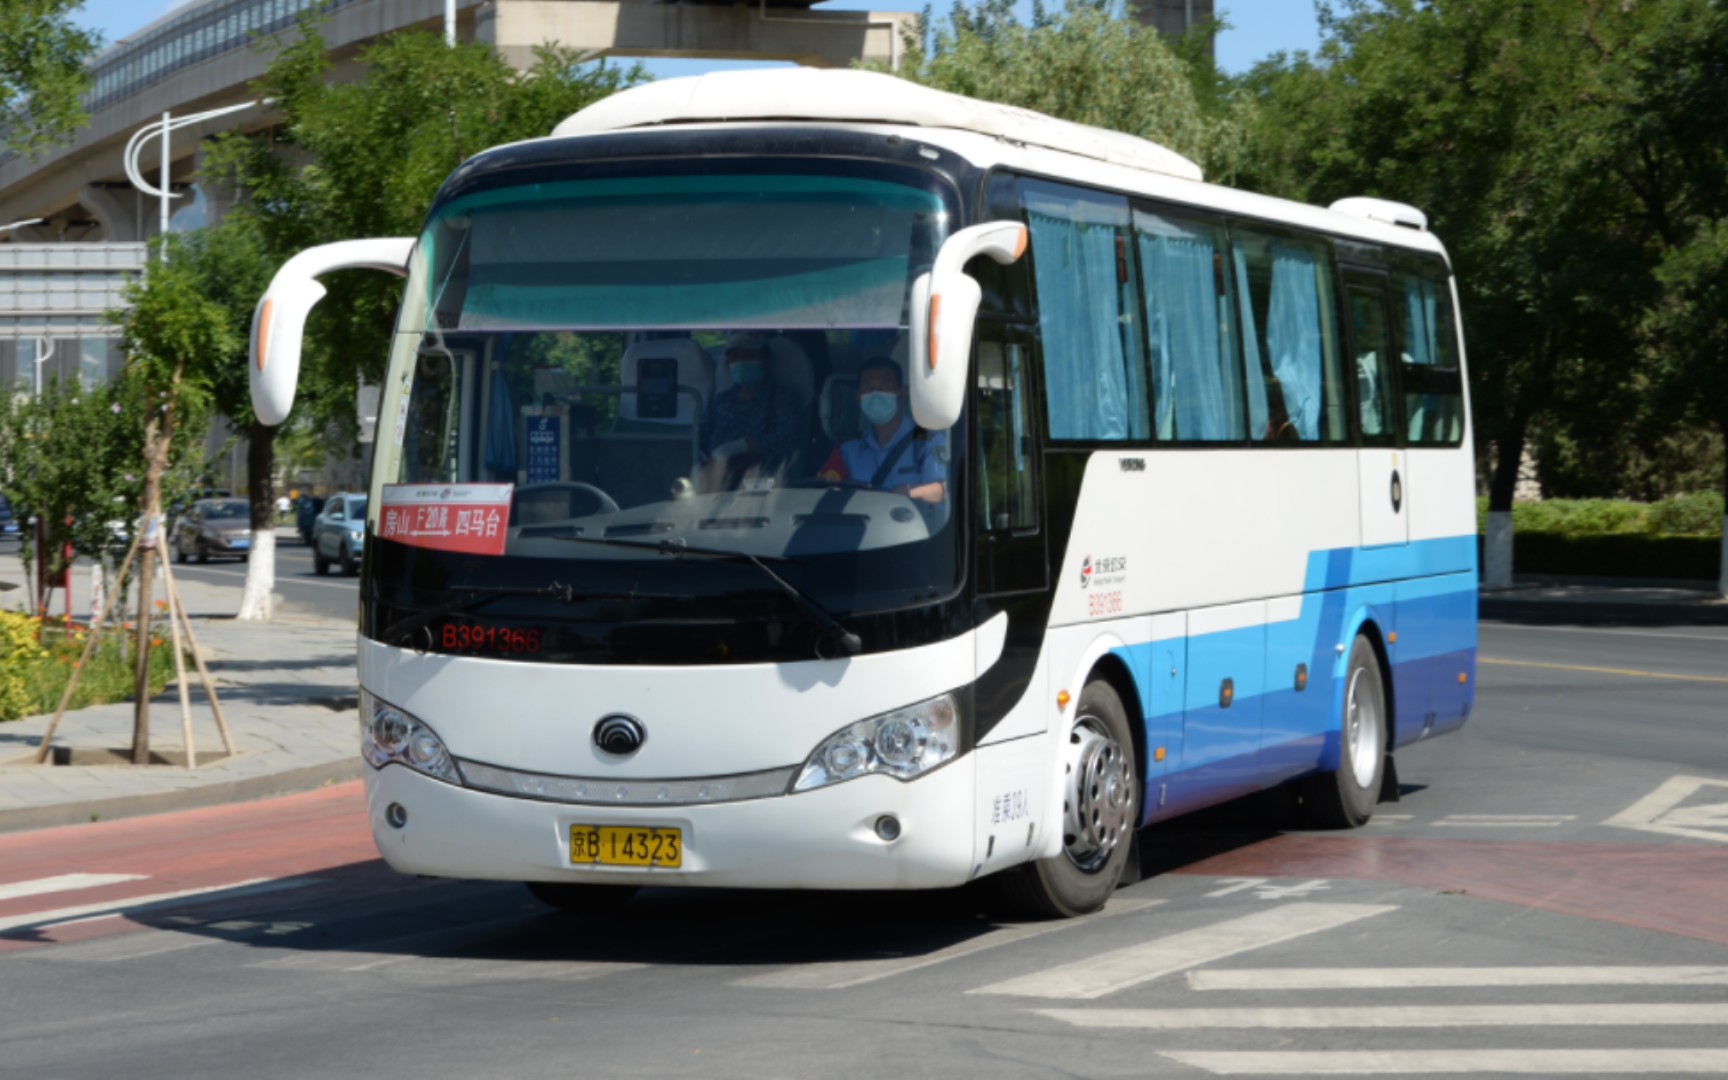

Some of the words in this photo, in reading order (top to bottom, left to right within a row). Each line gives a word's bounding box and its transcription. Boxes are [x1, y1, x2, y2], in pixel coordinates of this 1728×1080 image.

[384, 509, 410, 537] 房山
[455, 508, 500, 537] 四马台
[1088, 590, 1122, 617] B391366
[442, 624, 540, 654] B391366
